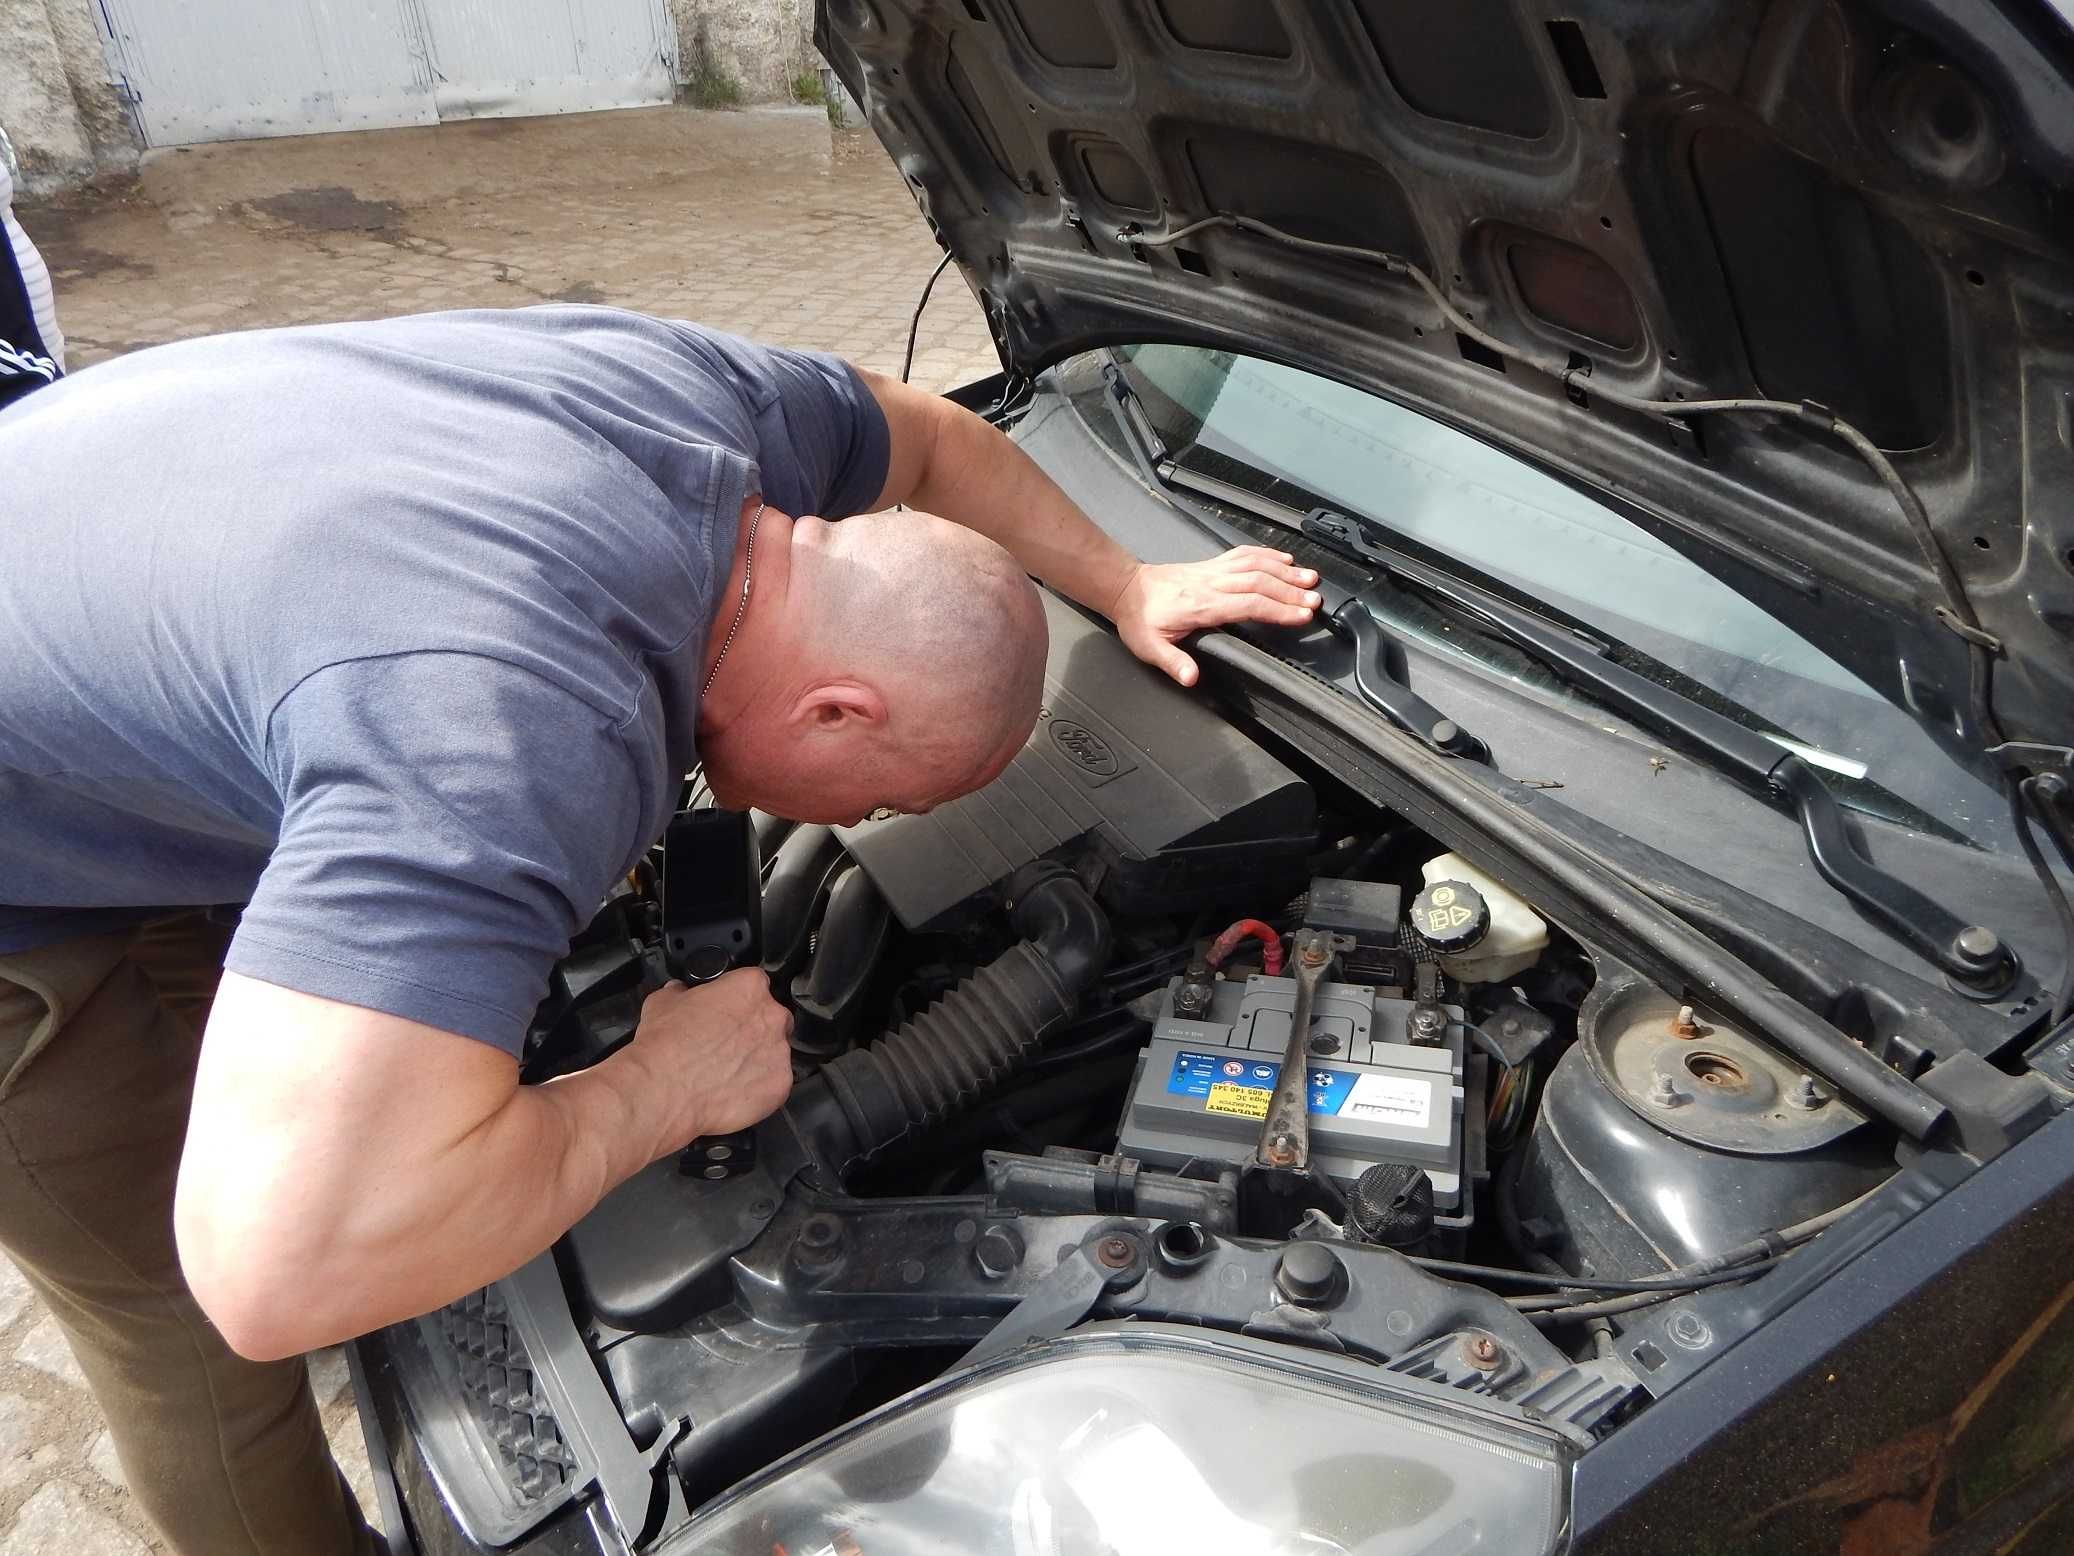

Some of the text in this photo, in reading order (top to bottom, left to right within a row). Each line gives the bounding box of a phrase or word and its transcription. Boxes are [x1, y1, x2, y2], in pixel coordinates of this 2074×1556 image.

[1057, 729, 1107, 765] Ford
[1212, 1083, 1230, 1092] 345
[1230, 1086, 1244, 1094] 140
